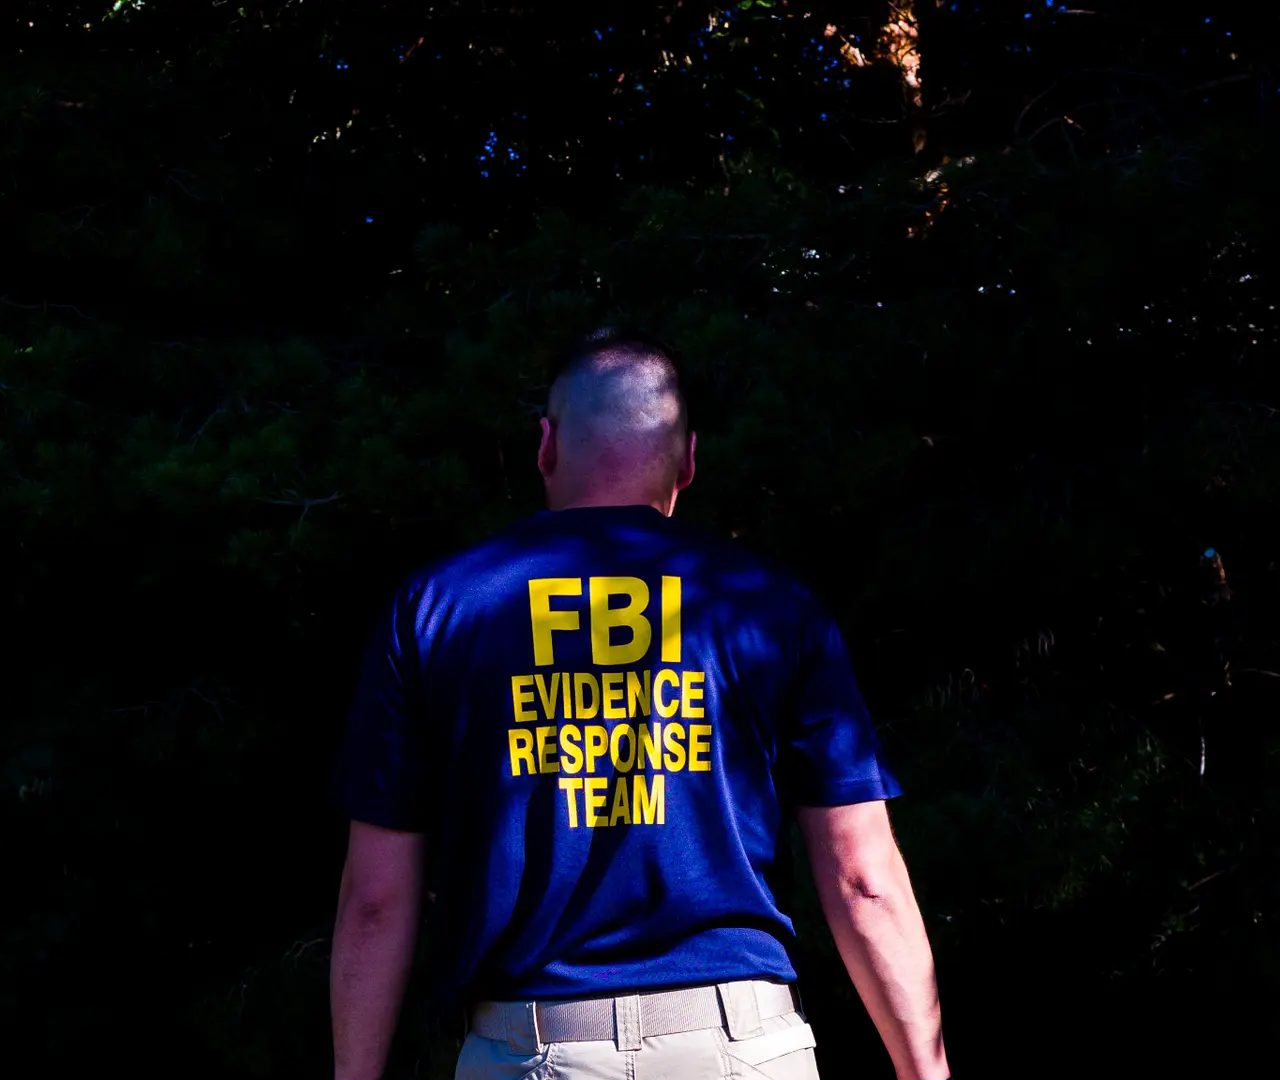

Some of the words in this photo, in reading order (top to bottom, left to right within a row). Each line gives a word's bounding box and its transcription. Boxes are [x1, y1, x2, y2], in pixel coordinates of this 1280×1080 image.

[528, 575, 681, 666] FBI
[511, 669, 705, 722] EVIDENCE
[508, 722, 712, 776] RESPONSE
[558, 774, 665, 828] TEAM
